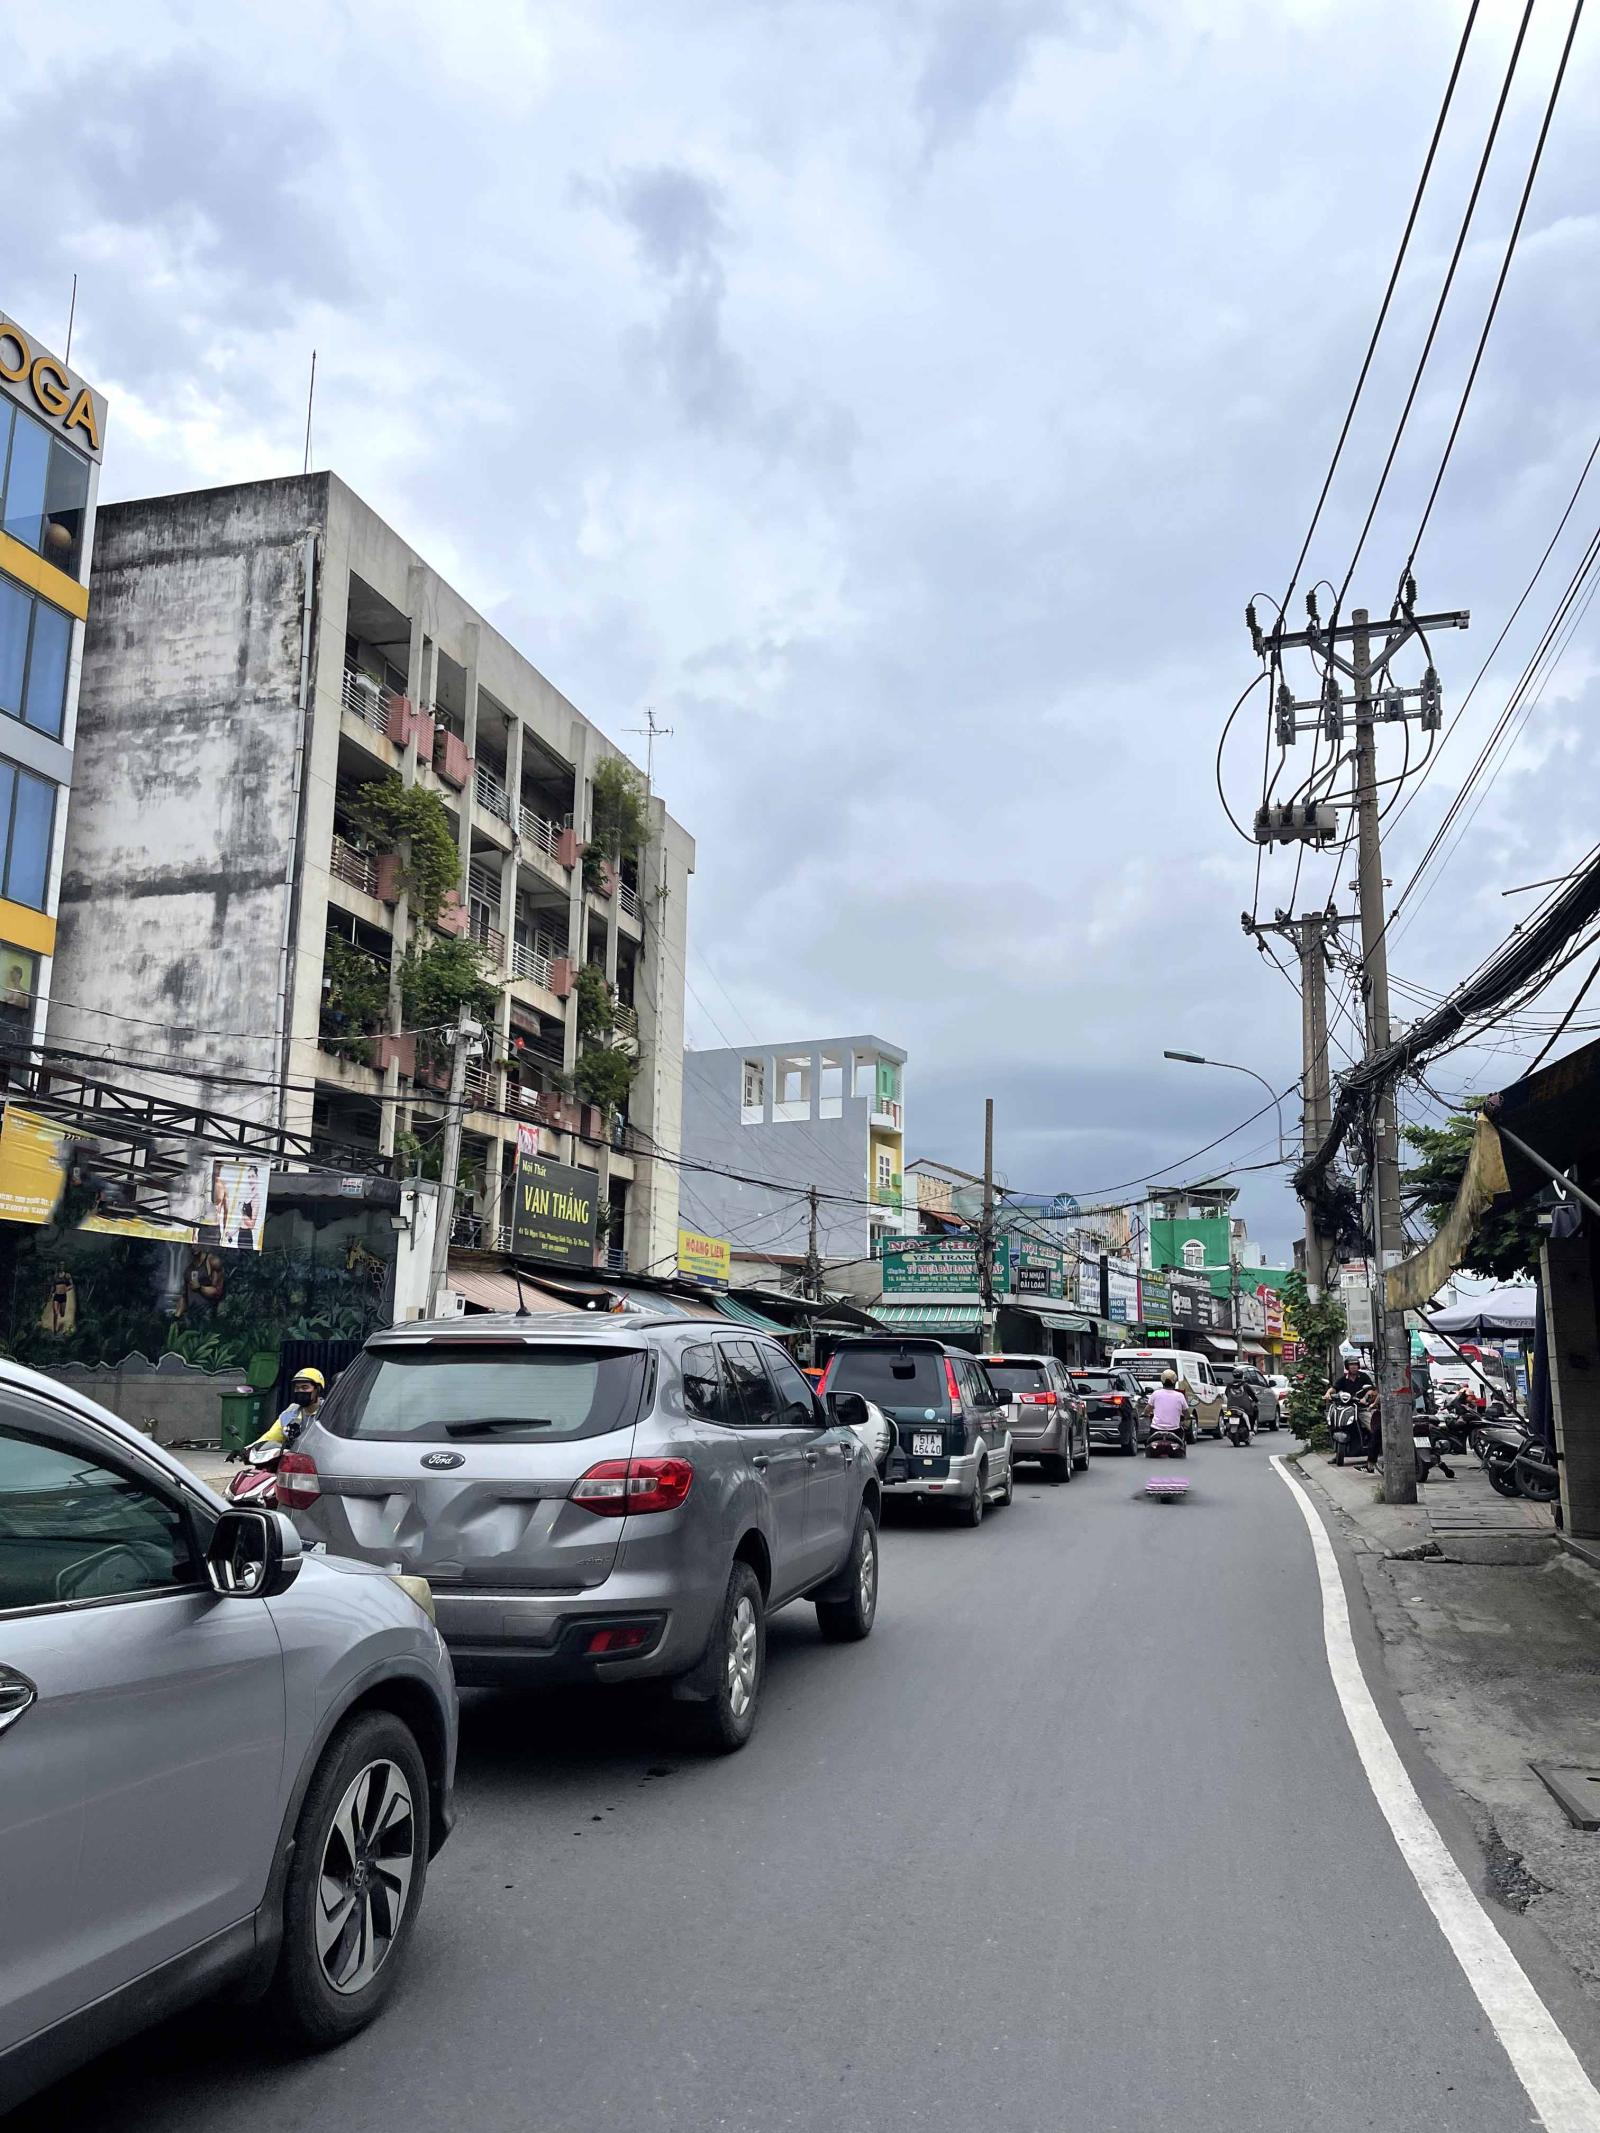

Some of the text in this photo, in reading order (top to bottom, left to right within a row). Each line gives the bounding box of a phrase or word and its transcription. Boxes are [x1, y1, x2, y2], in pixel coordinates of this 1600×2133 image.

[0, 323, 99, 450] OGA
[524, 1185, 590, 1224] VẠN THẮNG
[919, 1435, 935, 1444] 51A
[428, 1454, 454, 1465] Ford
